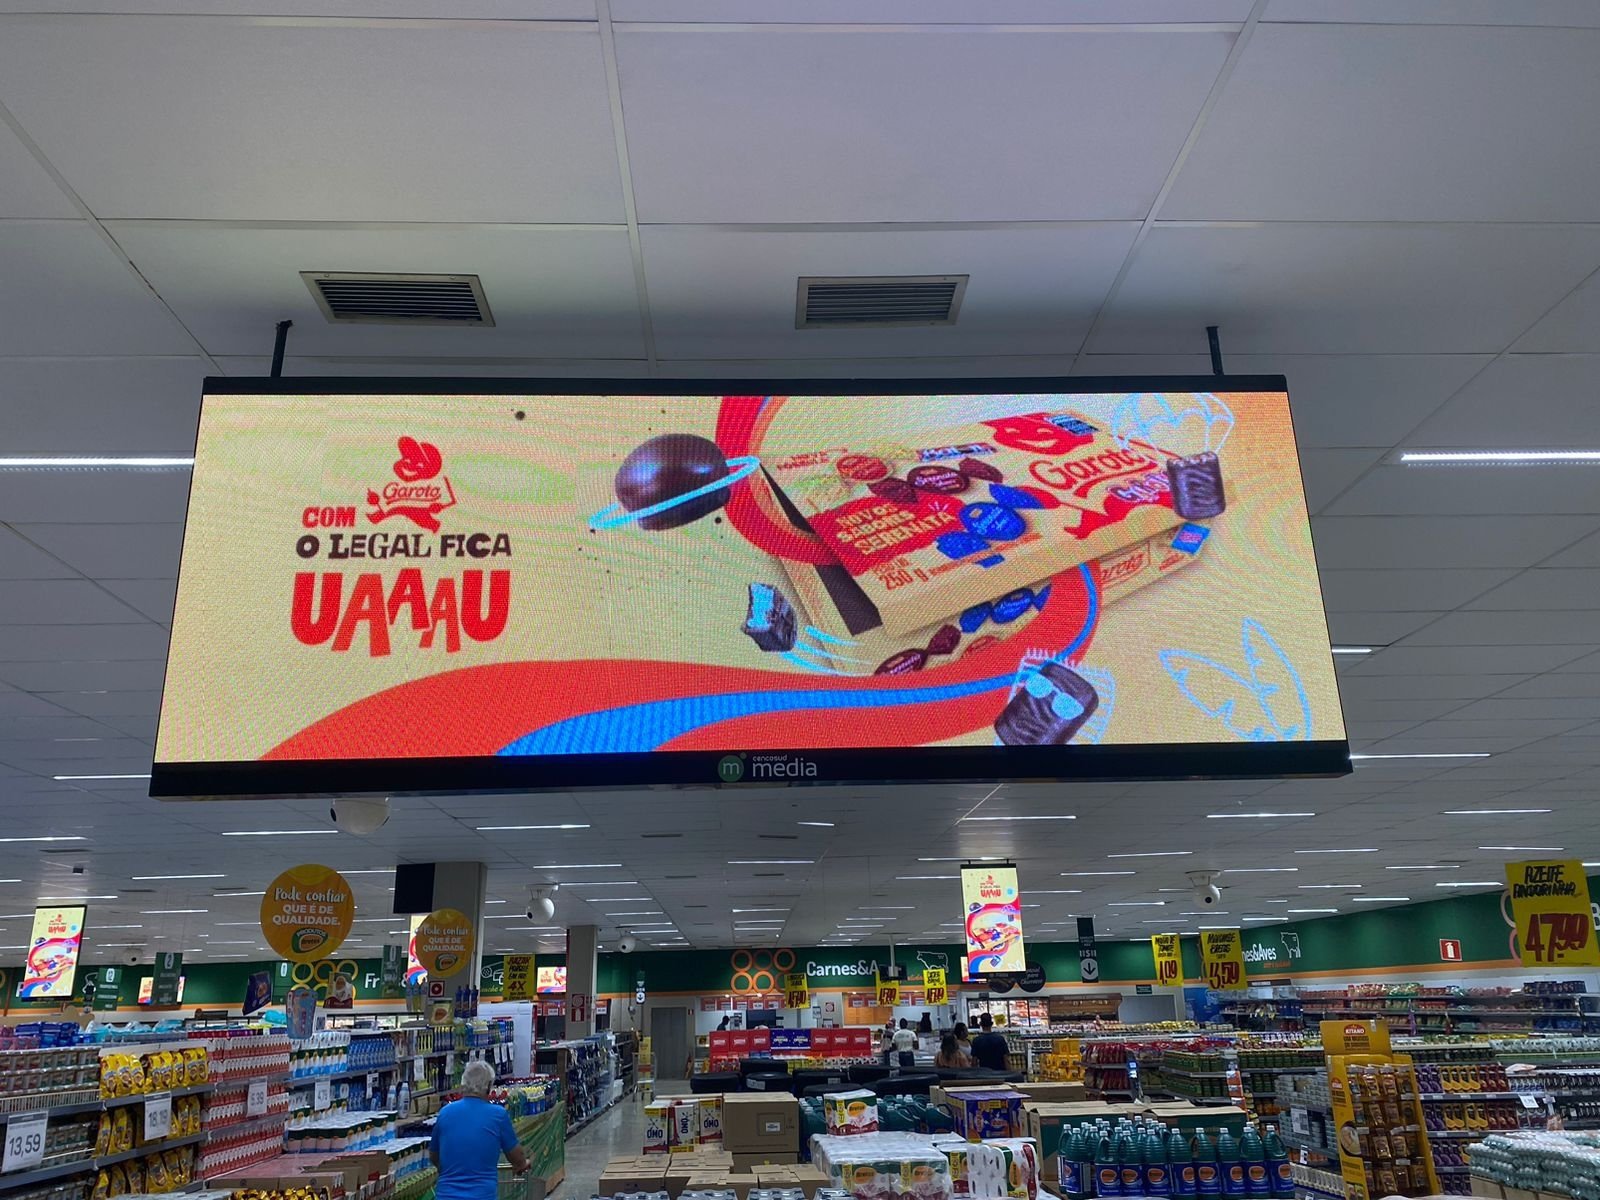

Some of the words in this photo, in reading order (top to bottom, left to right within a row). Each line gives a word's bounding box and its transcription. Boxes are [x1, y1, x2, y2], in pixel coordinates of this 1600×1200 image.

[383, 482, 442, 502] Garoto
[302, 507, 357, 528] COM
[854, 511, 955, 555] SERENATA
[296, 535, 320, 558] O
[328, 533, 431, 559] LEGAL
[440, 533, 512, 557] FICA
[291, 568, 511, 657] UAAAU
[752, 754, 788, 762] cencosud
[752, 758, 818, 777] media
[1525, 864, 1565, 884] AZEITE
[275, 886, 300, 901] Pode
[306, 888, 346, 903] confiar
[283, 905, 306, 914] QUE
[309, 903, 316, 913] É
[319, 906, 333, 914] DE
[272, 915, 340, 926] QUALIDADE.
[806, 960, 880, 976] Carnes&A
[704, 1119, 719, 1128] OMO
[647, 1128, 663, 1139] OMO
[9, 1132, 42, 1158] 13,59
